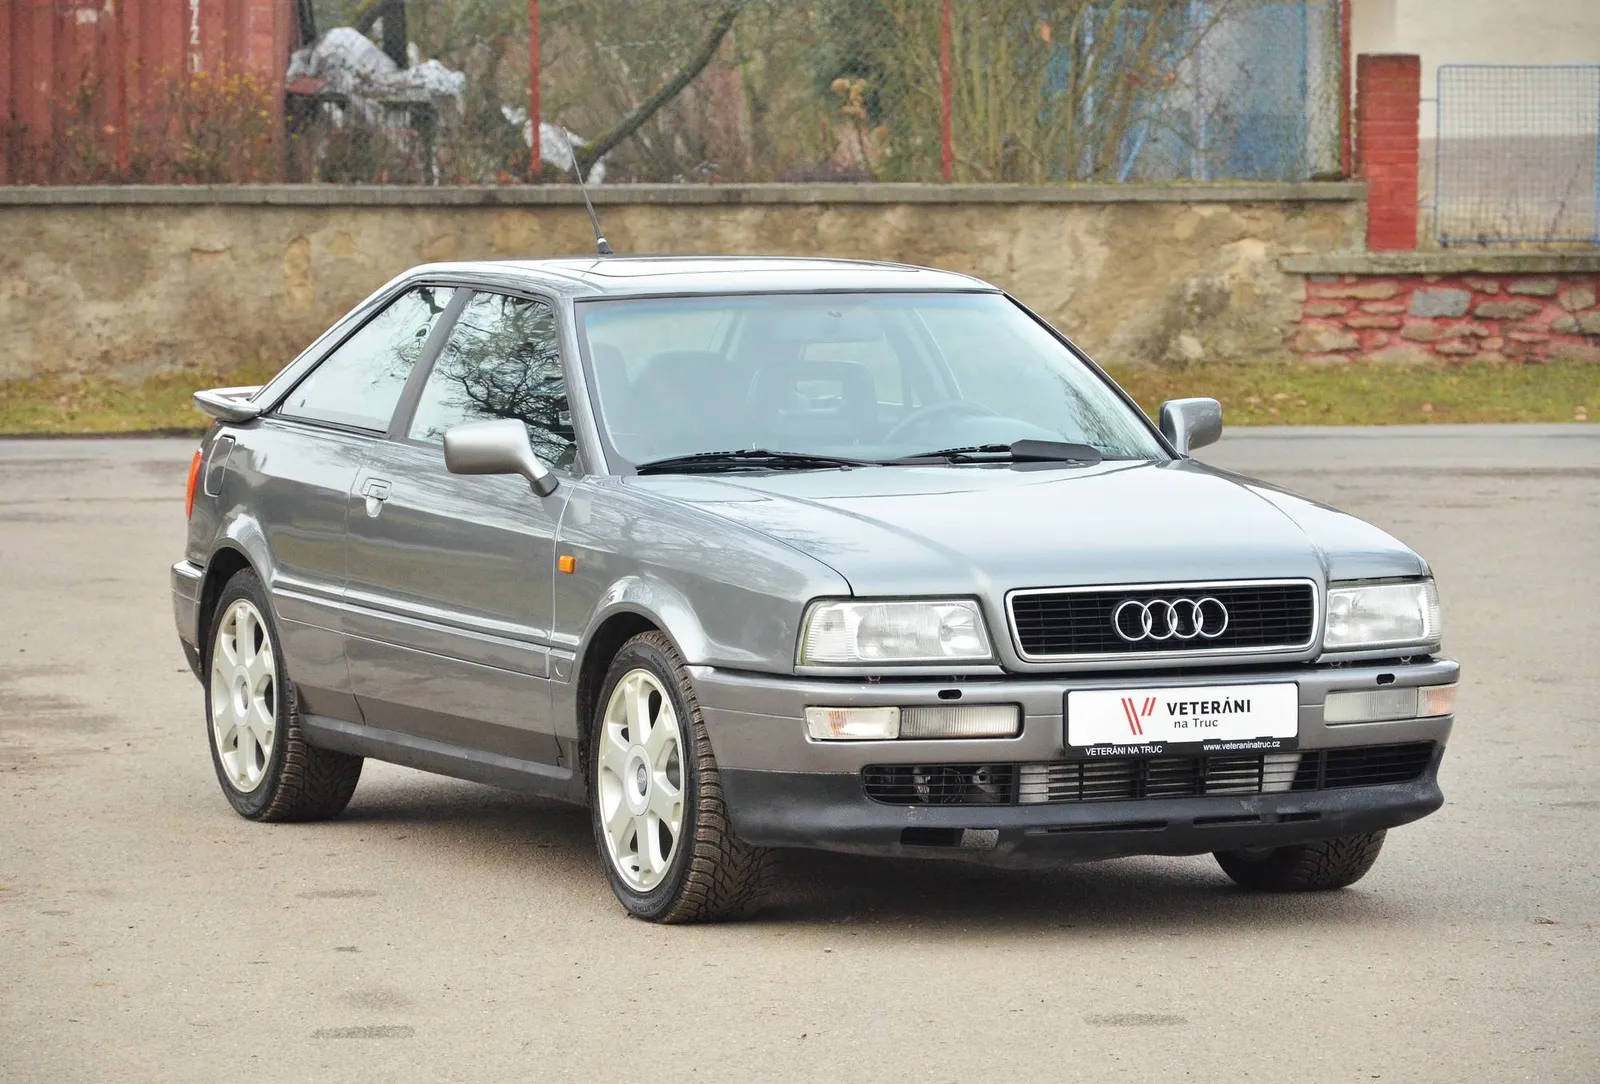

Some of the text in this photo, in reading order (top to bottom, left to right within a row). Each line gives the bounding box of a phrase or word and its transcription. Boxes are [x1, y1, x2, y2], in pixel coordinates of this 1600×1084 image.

[1166, 697, 1251, 716] VETERÁNI
[1174, 718, 1219, 729] na Truc
[1085, 745, 1163, 756] VETERÁNI NA TRUC
[1203, 740, 1281, 751] www.veteraninatruc.cz
